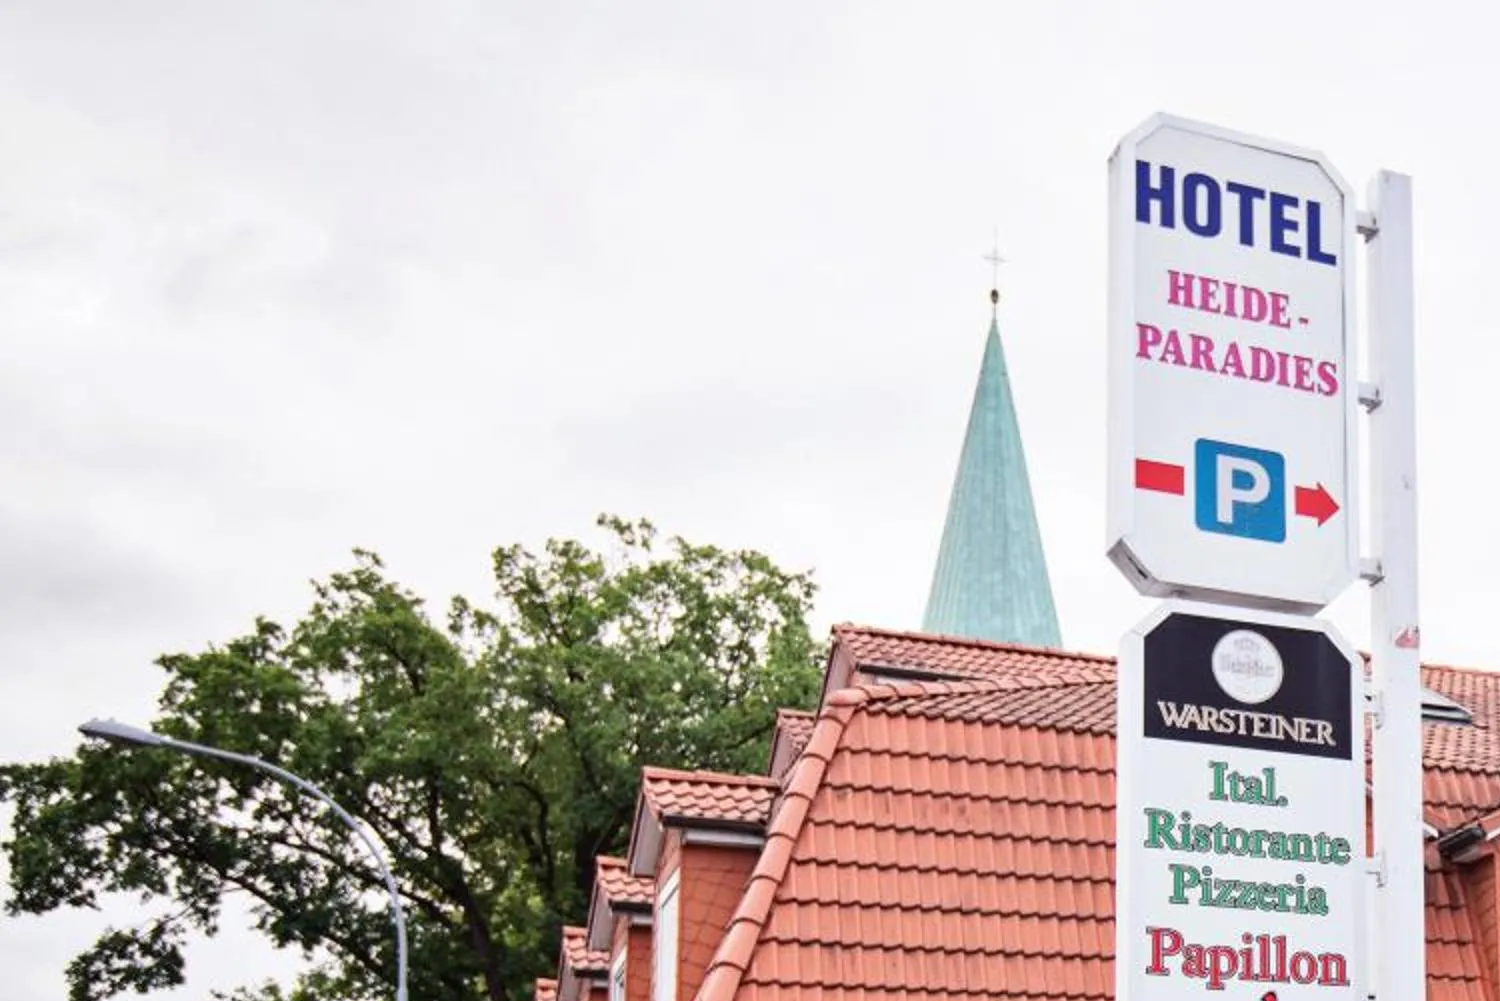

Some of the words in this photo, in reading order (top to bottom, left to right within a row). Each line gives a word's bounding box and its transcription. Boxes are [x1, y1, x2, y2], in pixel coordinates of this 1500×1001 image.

[1135, 159, 1337, 267] HOTEL
[1167, 270, 1309, 330] HEIDE-
[1136, 323, 1340, 397] PARADIES
[1215, 454, 1271, 524] P
[1157, 700, 1336, 746] WARSTEINER
[1209, 760, 1289, 806] Ital.
[1144, 807, 1351, 865] Ristorante
[1169, 863, 1329, 917] Pizzeria
[1145, 926, 1351, 991] Papillon
